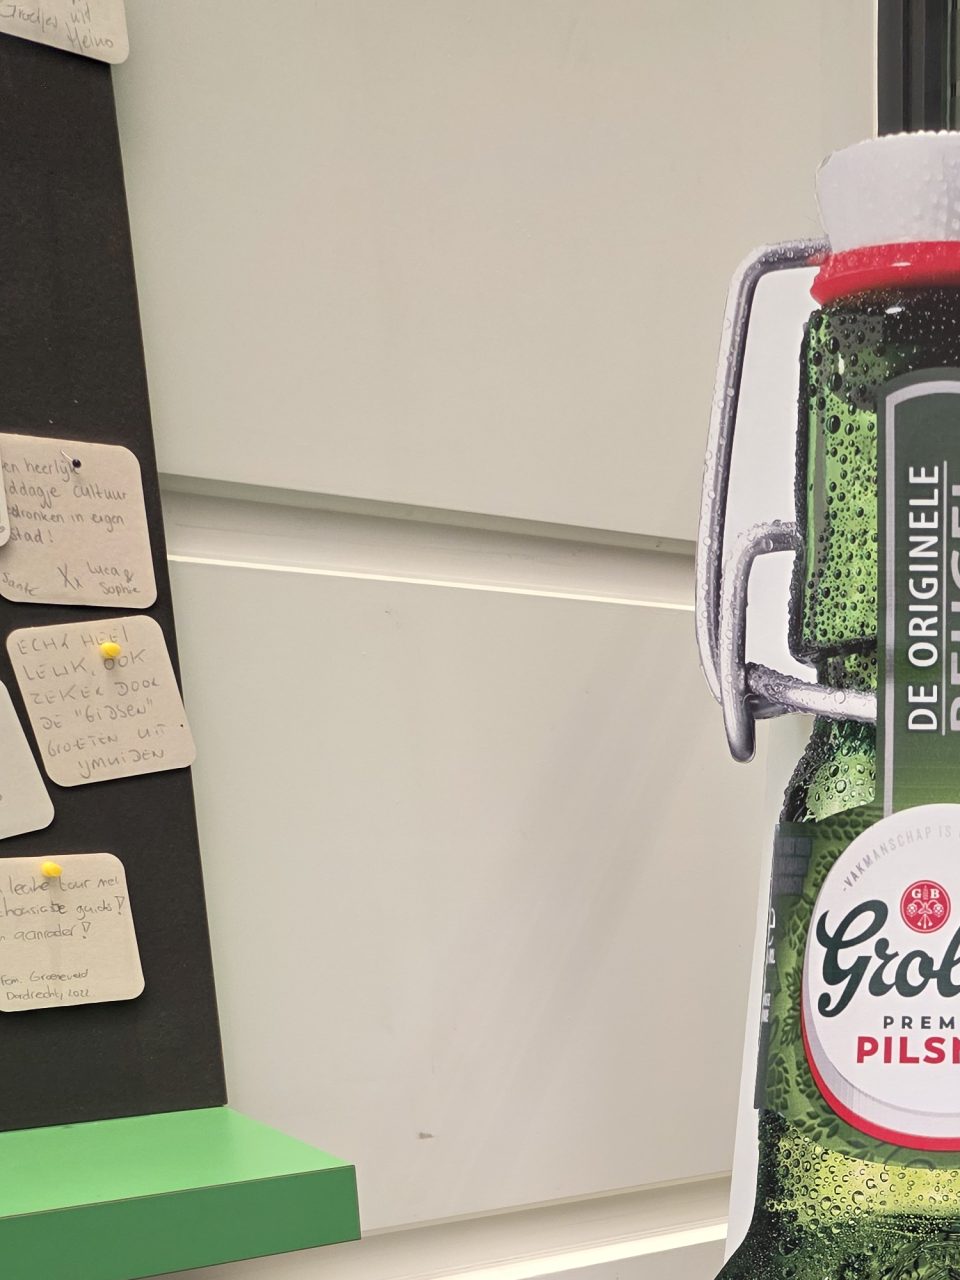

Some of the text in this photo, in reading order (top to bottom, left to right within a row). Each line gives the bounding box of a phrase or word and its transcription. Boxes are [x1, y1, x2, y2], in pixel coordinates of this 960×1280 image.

[908, 465, 939, 731] DE ORIGINELE
[938, 825, 952, 838] IS
